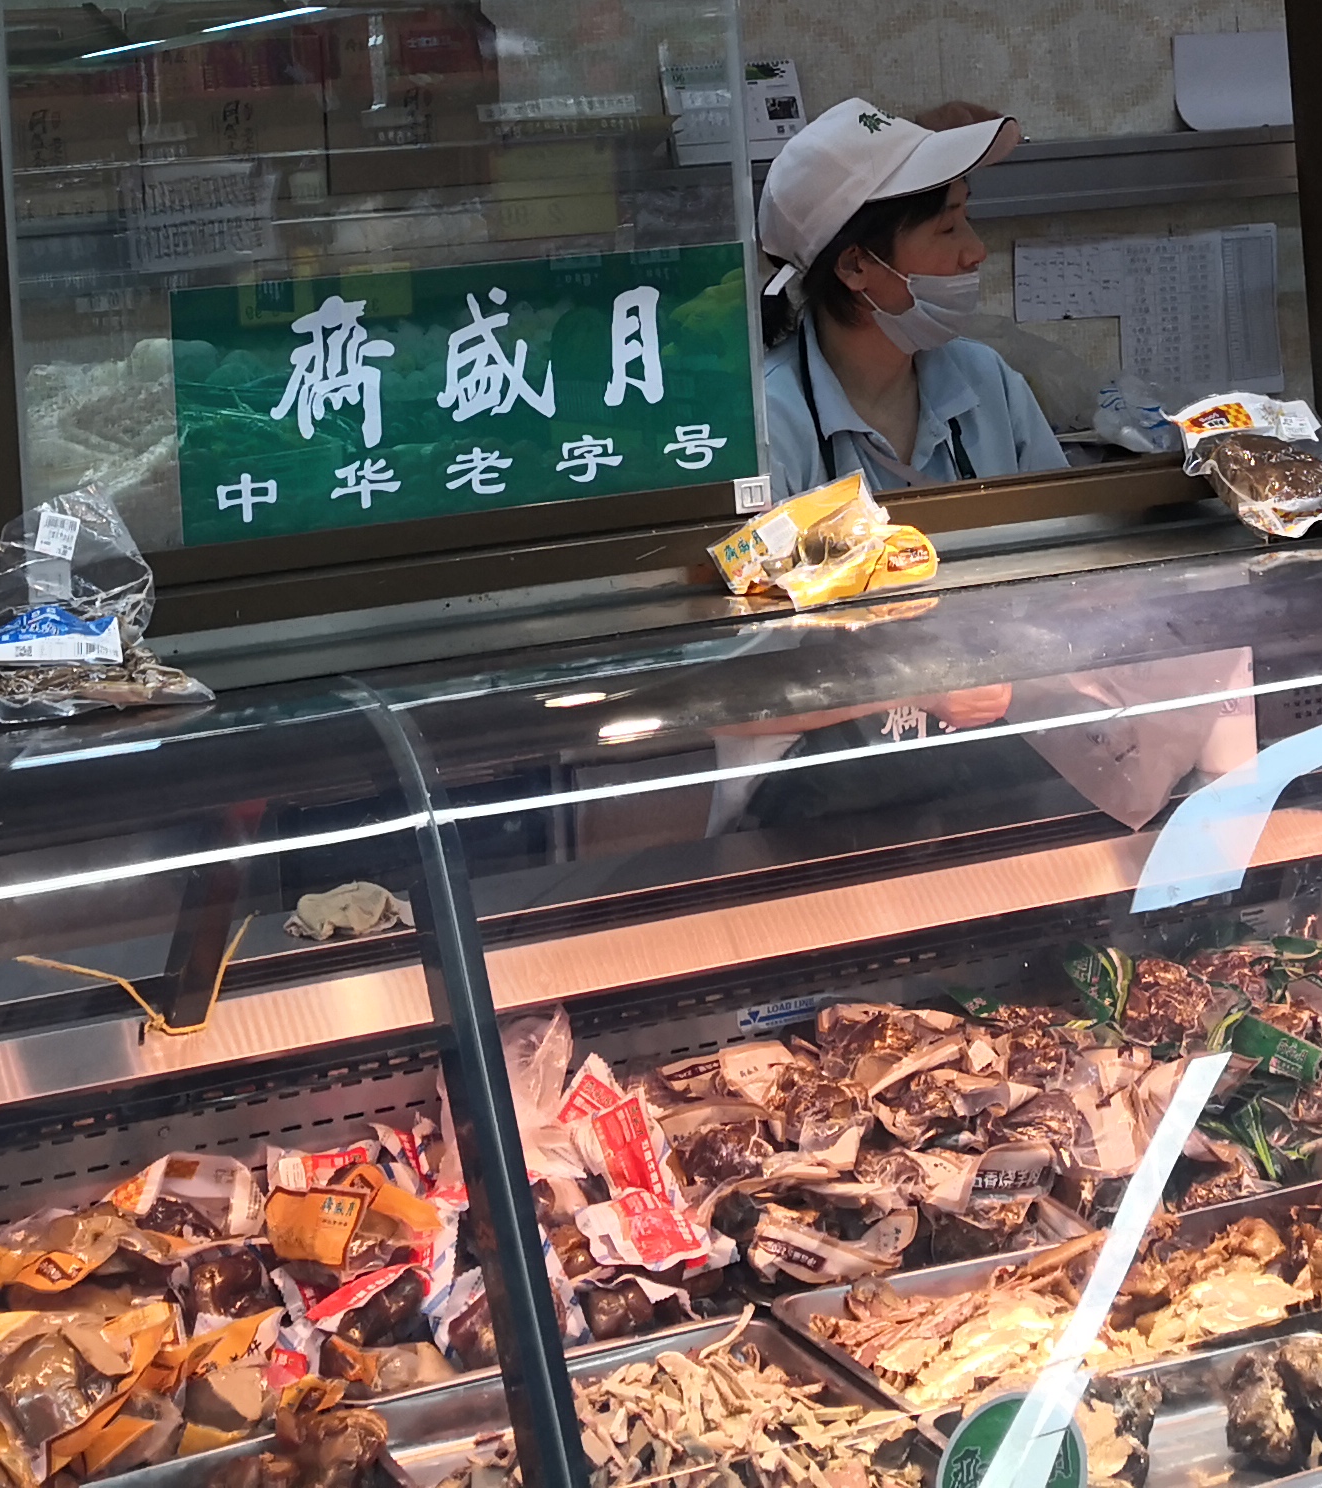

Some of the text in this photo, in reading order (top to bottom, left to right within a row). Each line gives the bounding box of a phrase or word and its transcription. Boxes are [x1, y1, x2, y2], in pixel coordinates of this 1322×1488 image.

[216, 424, 727, 523] 中华老字号
[767, 1001, 792, 1015] LOAD
